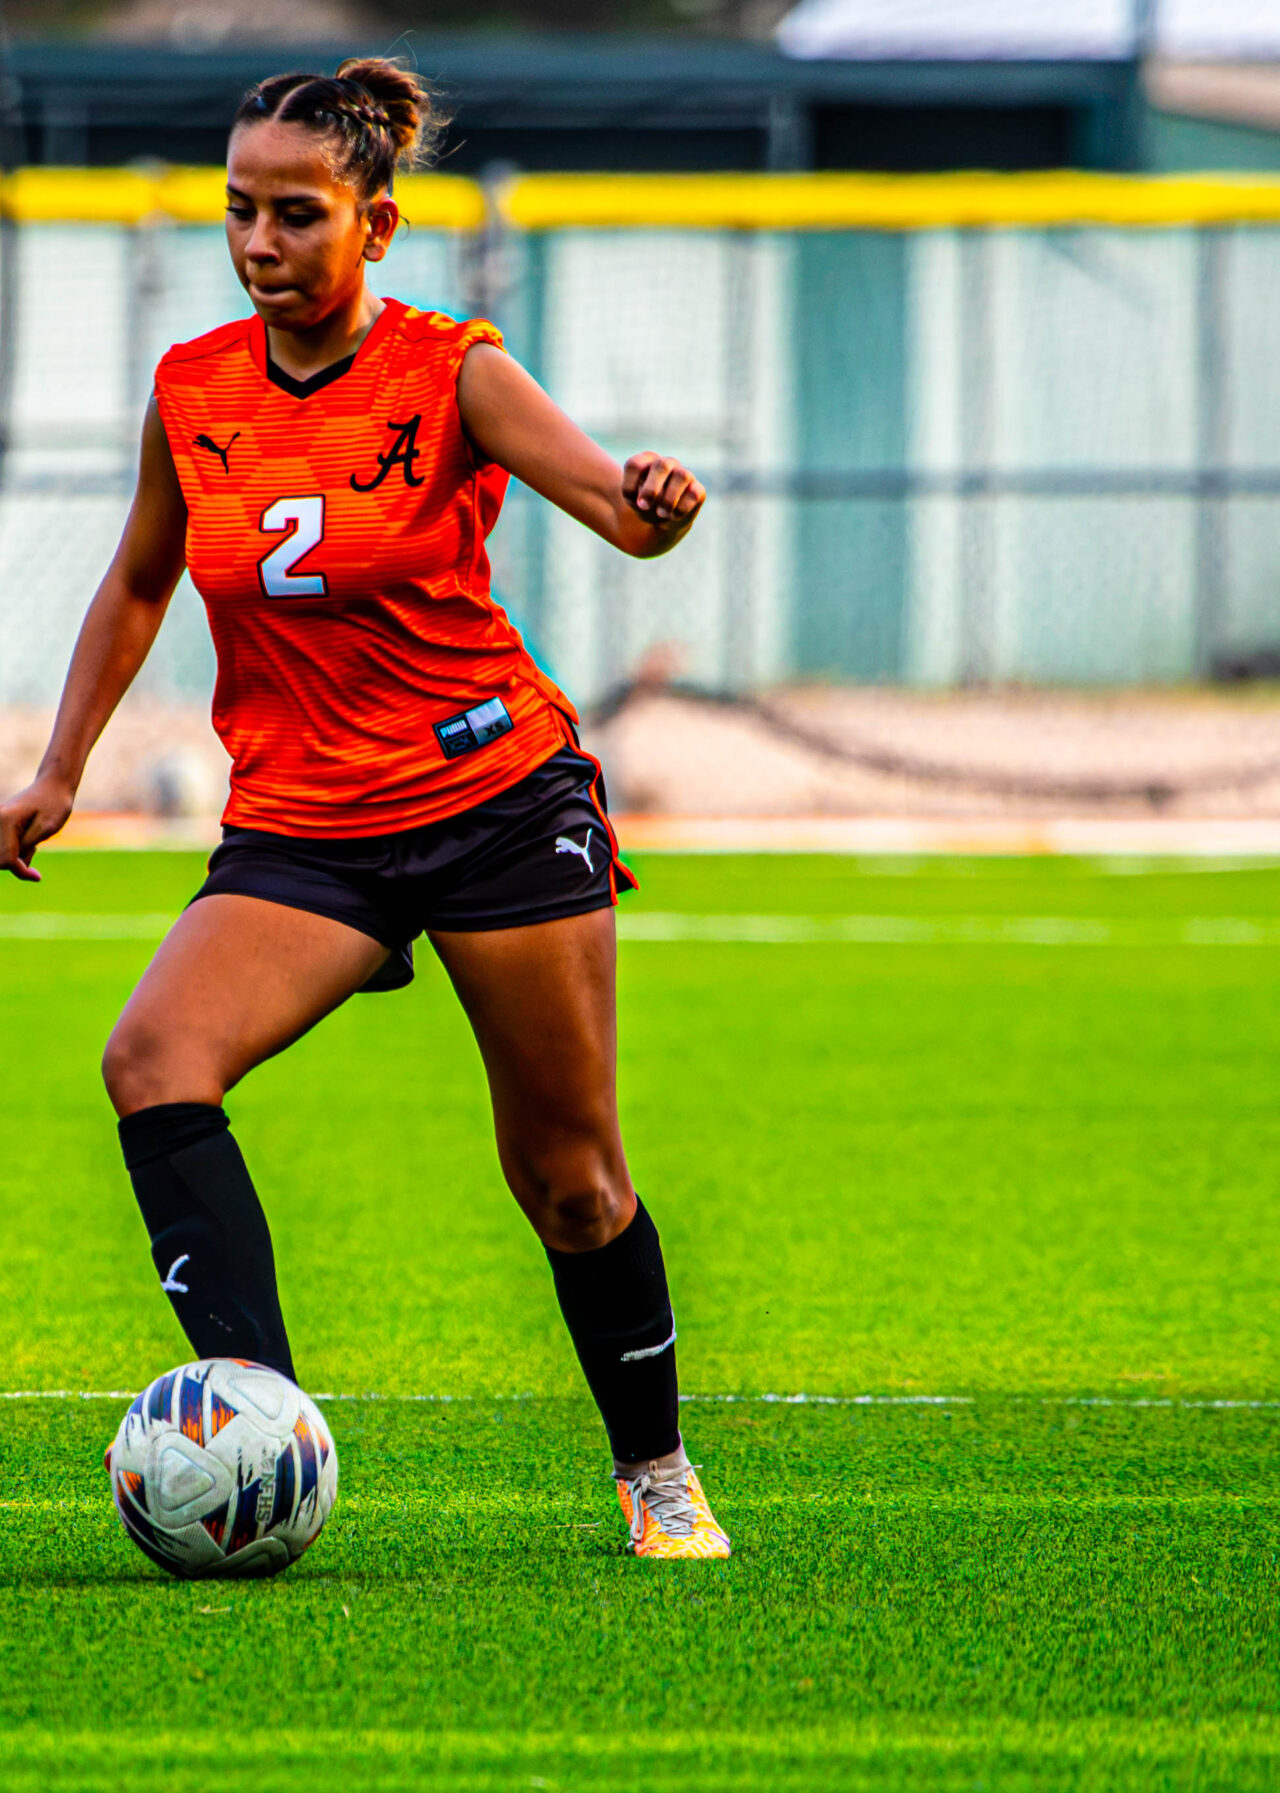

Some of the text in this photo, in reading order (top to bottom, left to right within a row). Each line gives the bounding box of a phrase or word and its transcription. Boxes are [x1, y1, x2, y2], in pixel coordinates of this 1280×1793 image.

[350, 414, 425, 492] A
[256, 494, 329, 599] 2
[486, 721, 505, 737] XS
